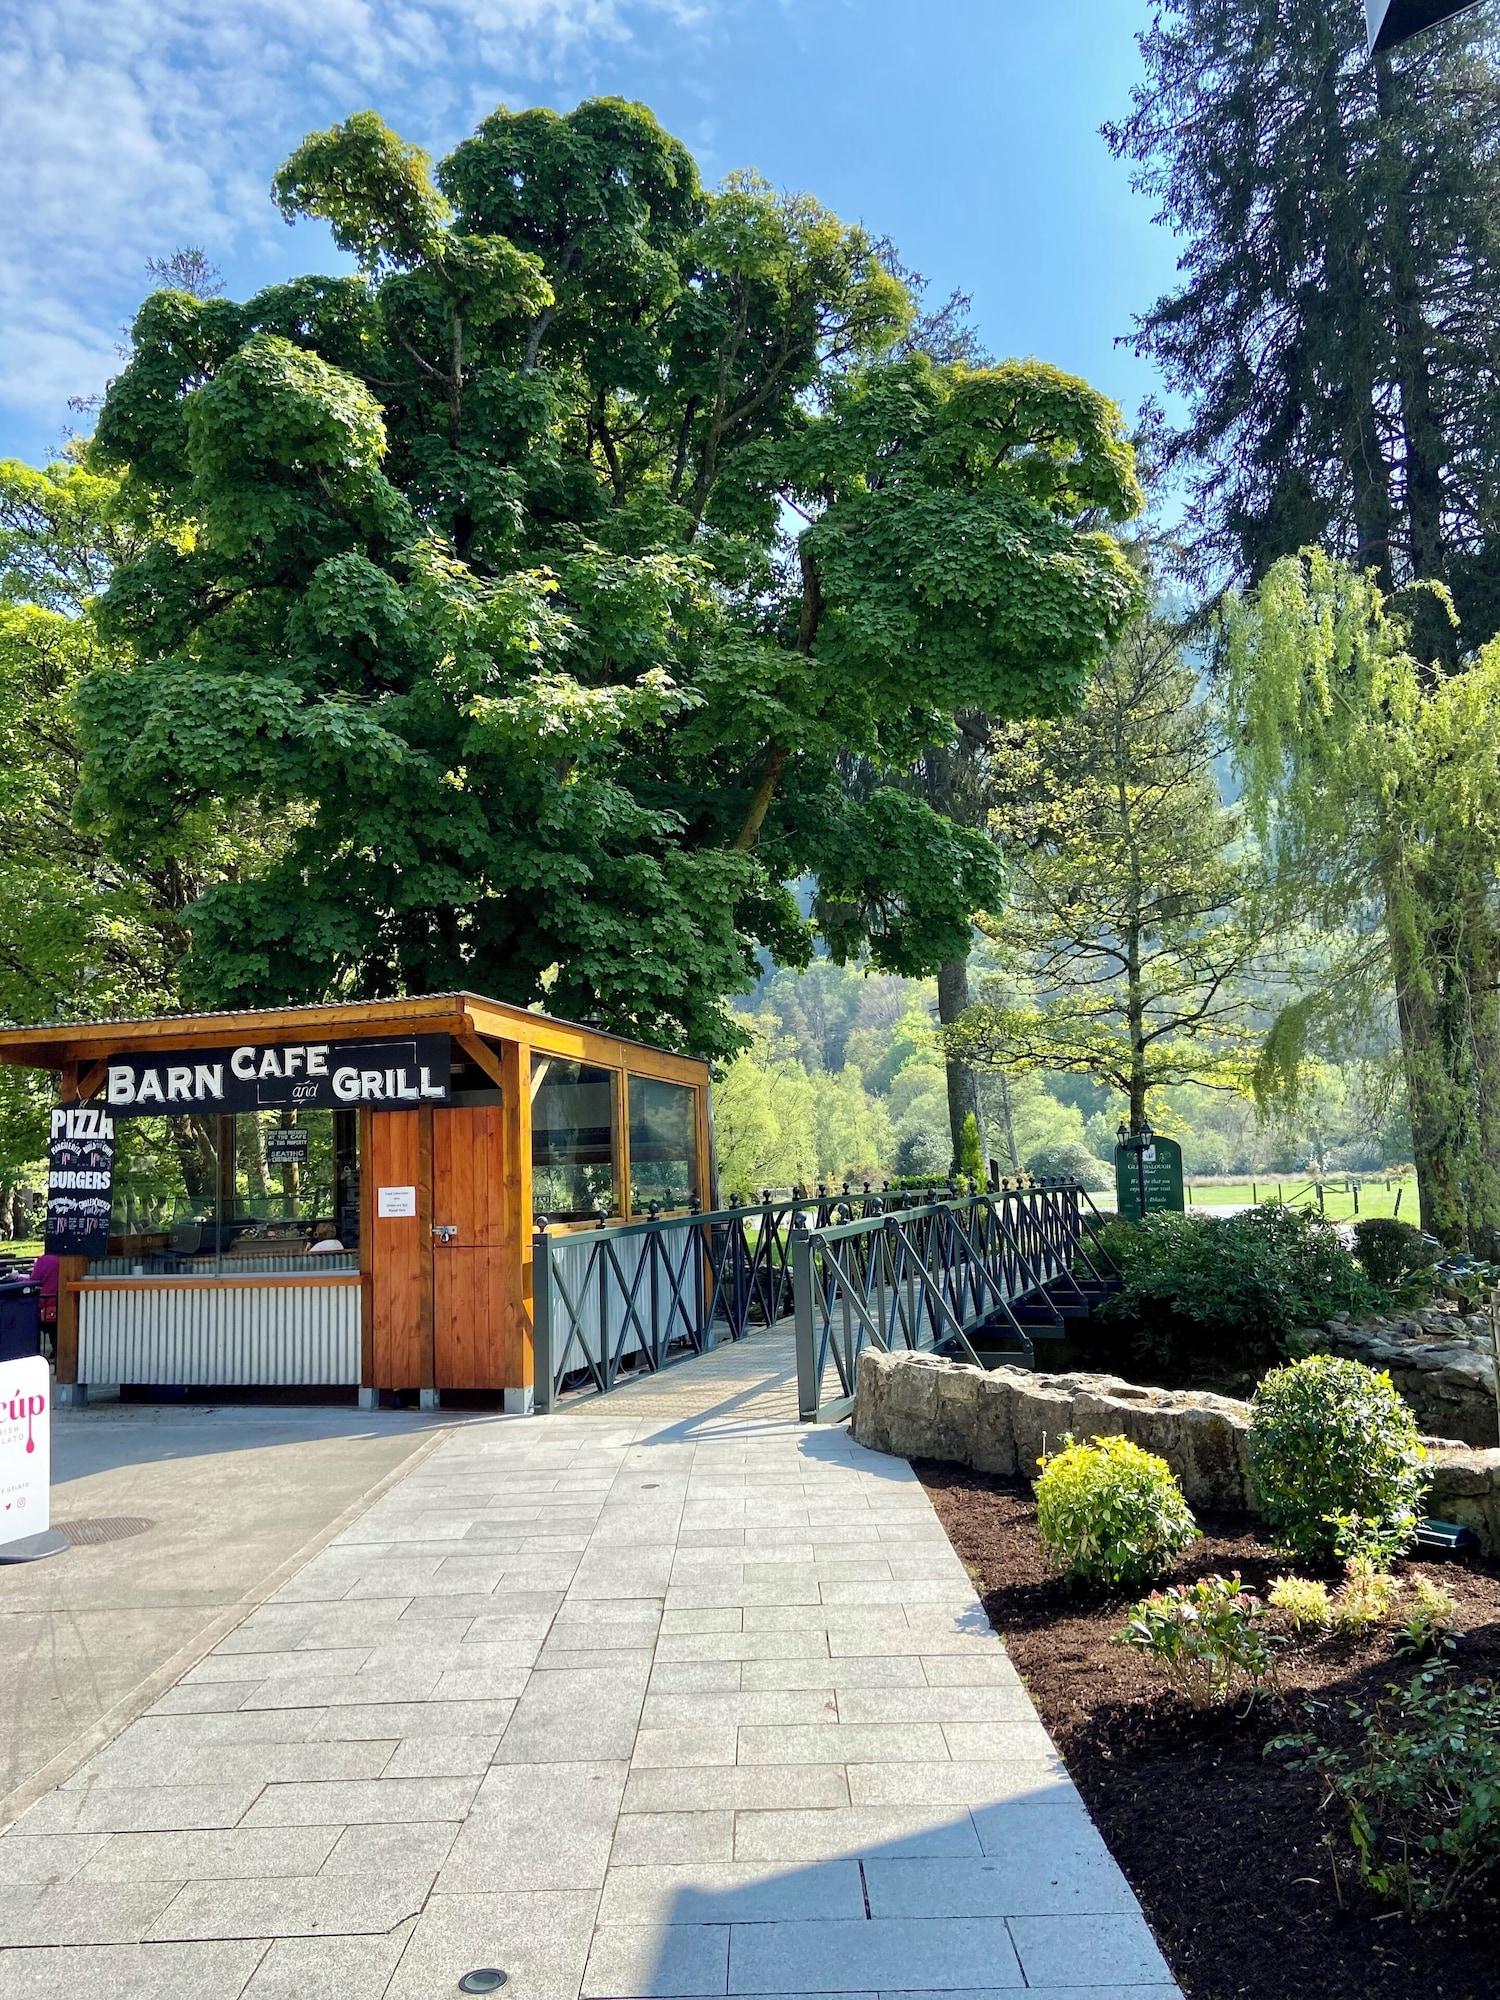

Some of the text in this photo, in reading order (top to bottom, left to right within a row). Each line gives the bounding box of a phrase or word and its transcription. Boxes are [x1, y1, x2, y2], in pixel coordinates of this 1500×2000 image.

[231, 1044, 330, 1080] CAFE
[107, 1063, 225, 1104] BARN
[292, 1083, 319, 1099] and
[332, 1066, 447, 1101] GRILL
[51, 1109, 114, 1139] PIZZA
[49, 1171, 111, 1190] BURGERS
